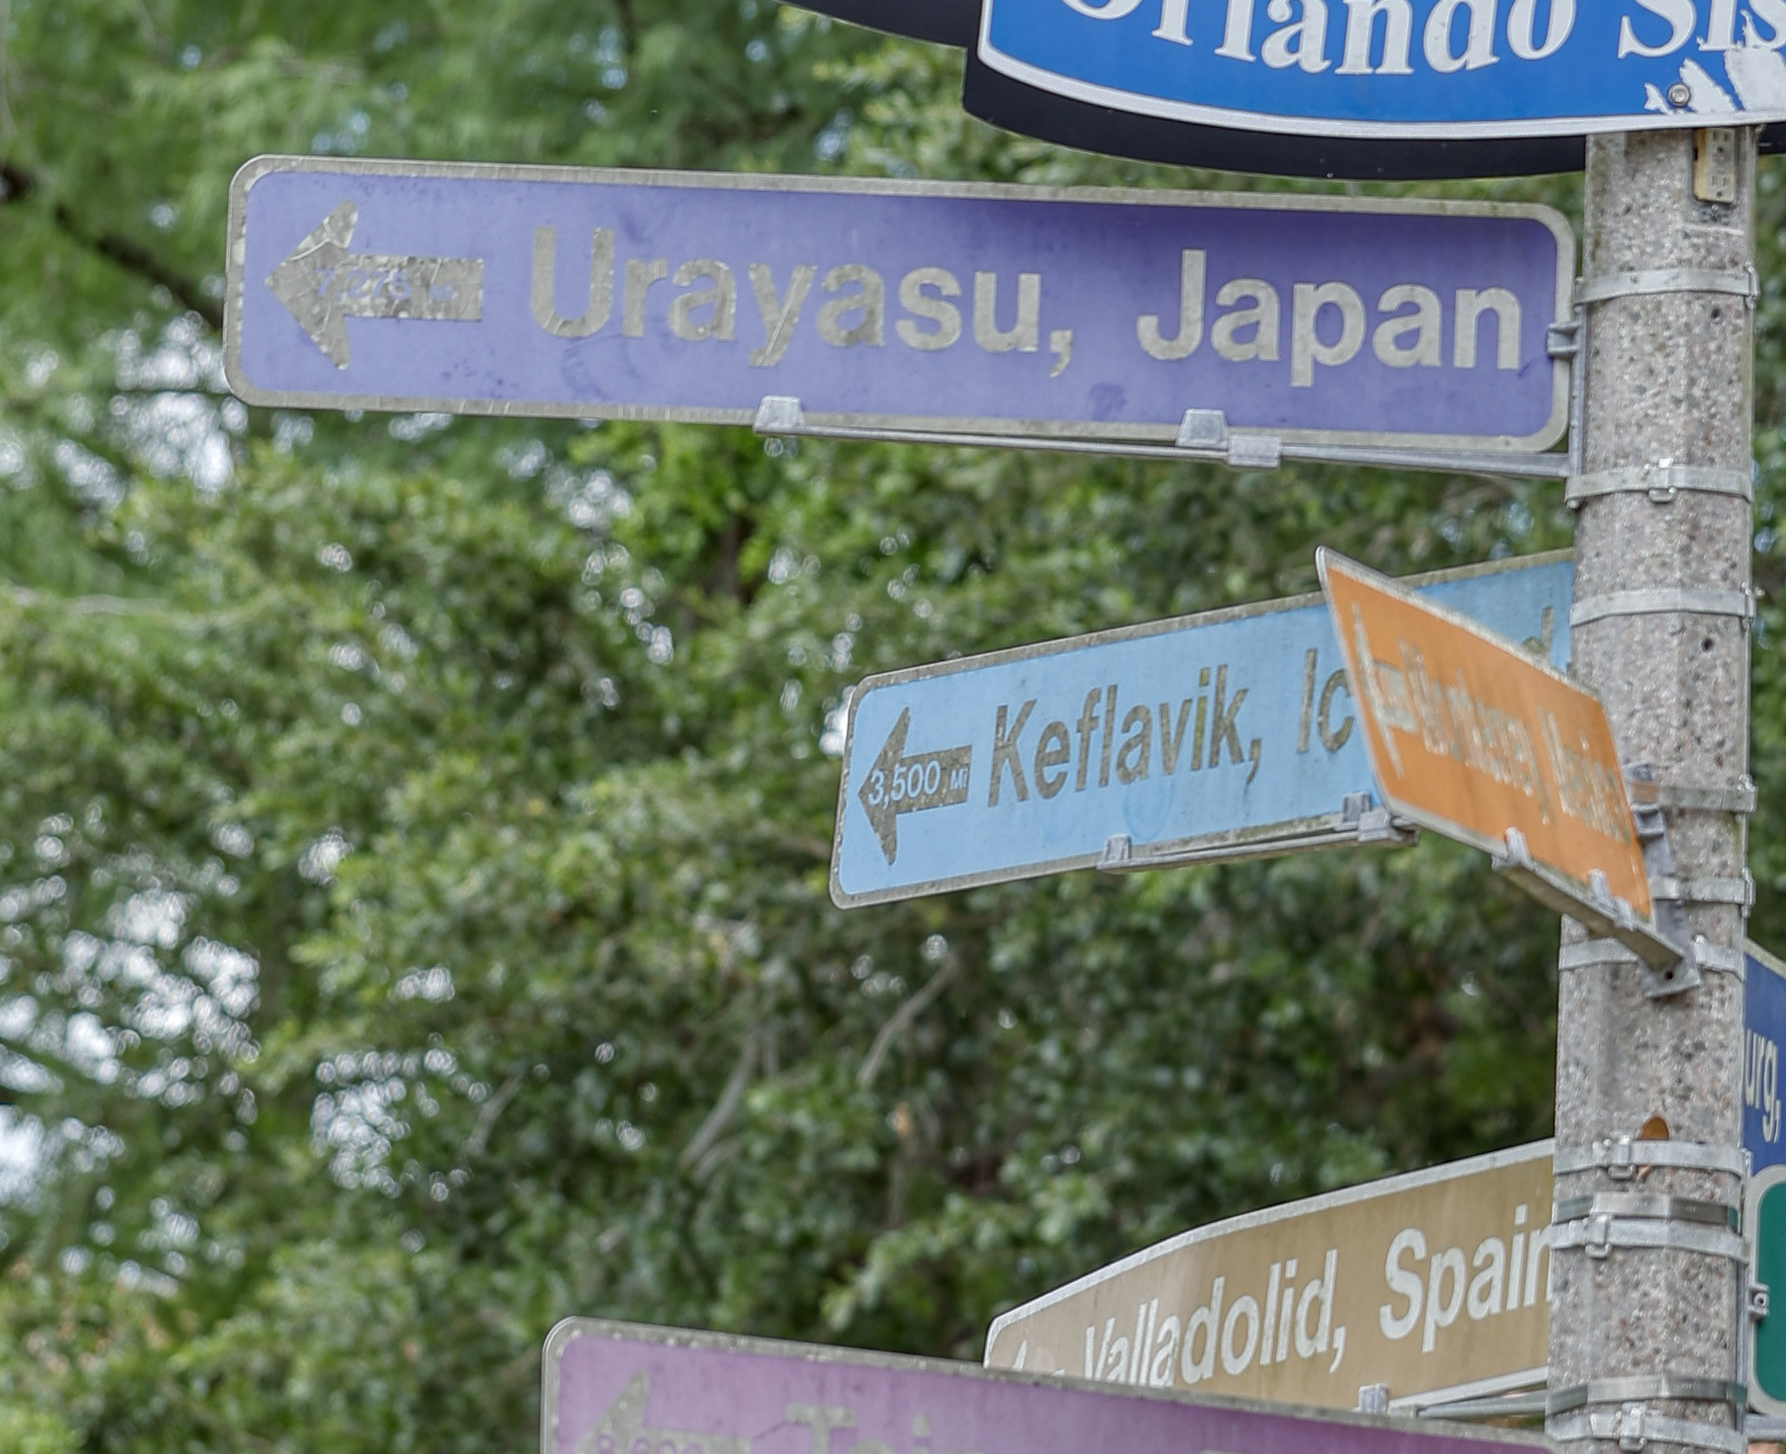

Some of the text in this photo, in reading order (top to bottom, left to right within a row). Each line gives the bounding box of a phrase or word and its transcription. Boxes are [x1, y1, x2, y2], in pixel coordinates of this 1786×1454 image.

[530, 225, 1522, 388] Urayasu, Japan
[867, 759, 942, 810] 3,500
[987, 663, 1263, 808] Keflavik,
[1084, 1203, 1553, 1387] Valladolid, Spain
